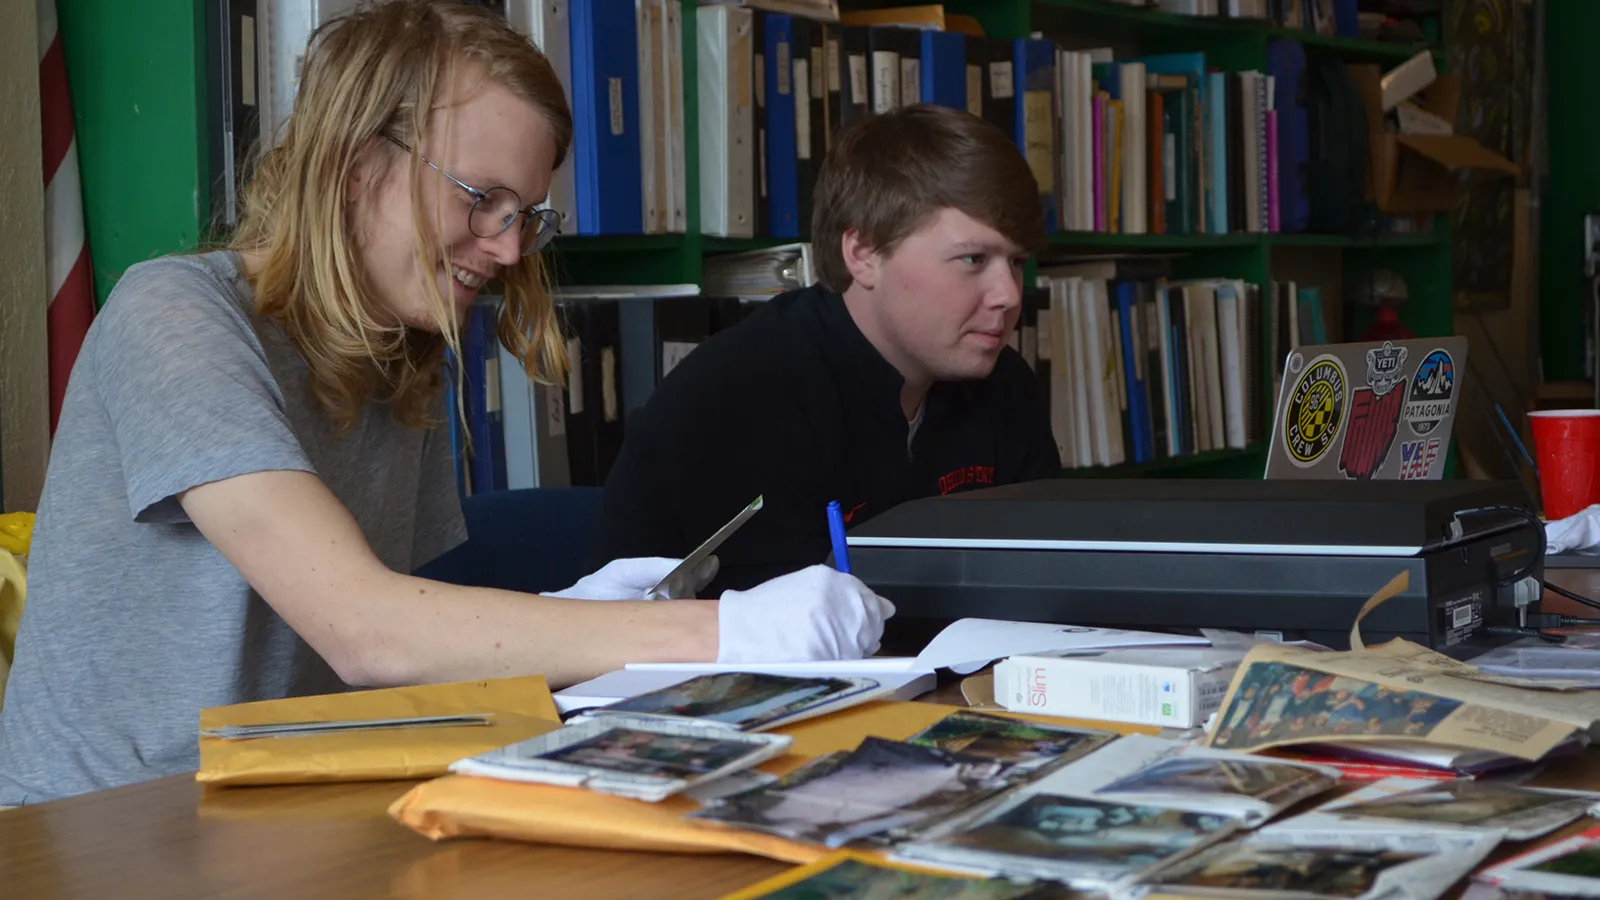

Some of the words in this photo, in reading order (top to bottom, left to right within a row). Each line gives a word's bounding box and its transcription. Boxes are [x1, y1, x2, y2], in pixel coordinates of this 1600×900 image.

[1377, 357, 1396, 369] YETI
[1295, 367, 1342, 404] COLUMBUS
[1404, 404, 1450, 418] PATAGONIA
[1290, 425, 1313, 456] CREW
[1321, 423, 1335, 446] SC
[1417, 422, 1431, 431] 1973
[938, 468, 965, 496] OHIO
[1031, 667, 1047, 707] Slim
